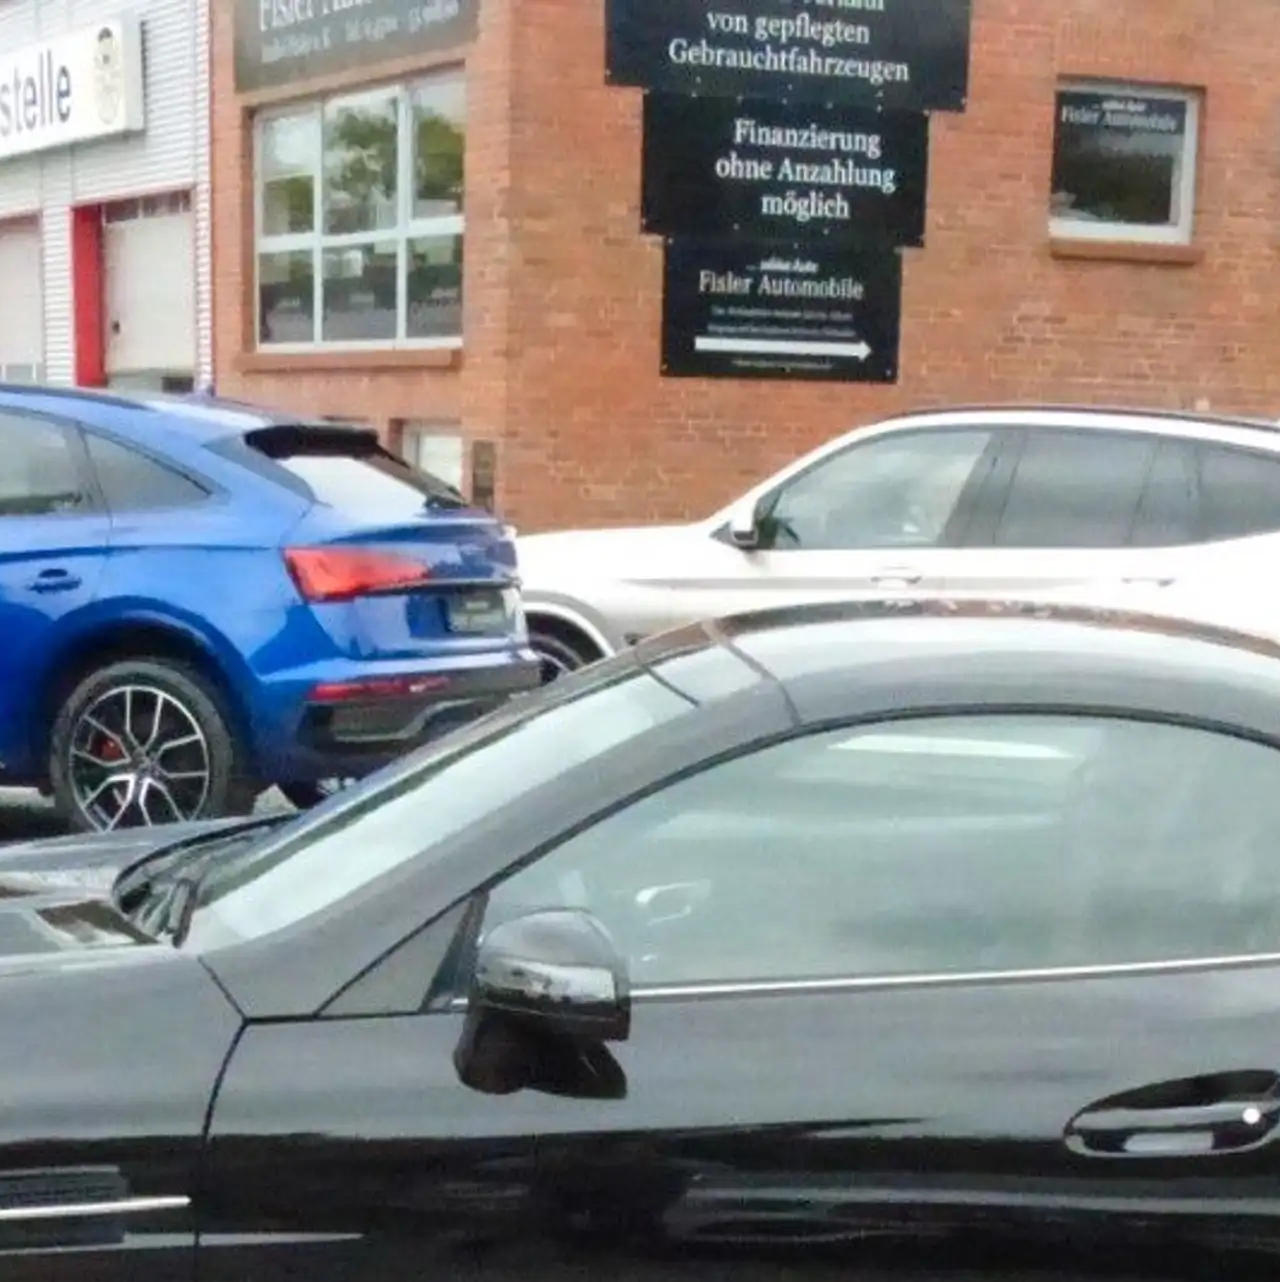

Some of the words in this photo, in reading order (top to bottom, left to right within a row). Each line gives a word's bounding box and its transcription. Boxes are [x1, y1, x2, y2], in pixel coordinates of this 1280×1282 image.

[707, 11, 748, 34] von
[754, 12, 871, 47] gepflegten
[668, 38, 910, 84] Gebrauchtfahrzeugen
[734, 118, 882, 158] Finanzierung
[715, 152, 772, 179] ohne
[777, 157, 896, 193] Anzahlung
[760, 191, 850, 222] möglich
[698, 269, 753, 295] Fisler
[757, 274, 864, 300] Automobile
